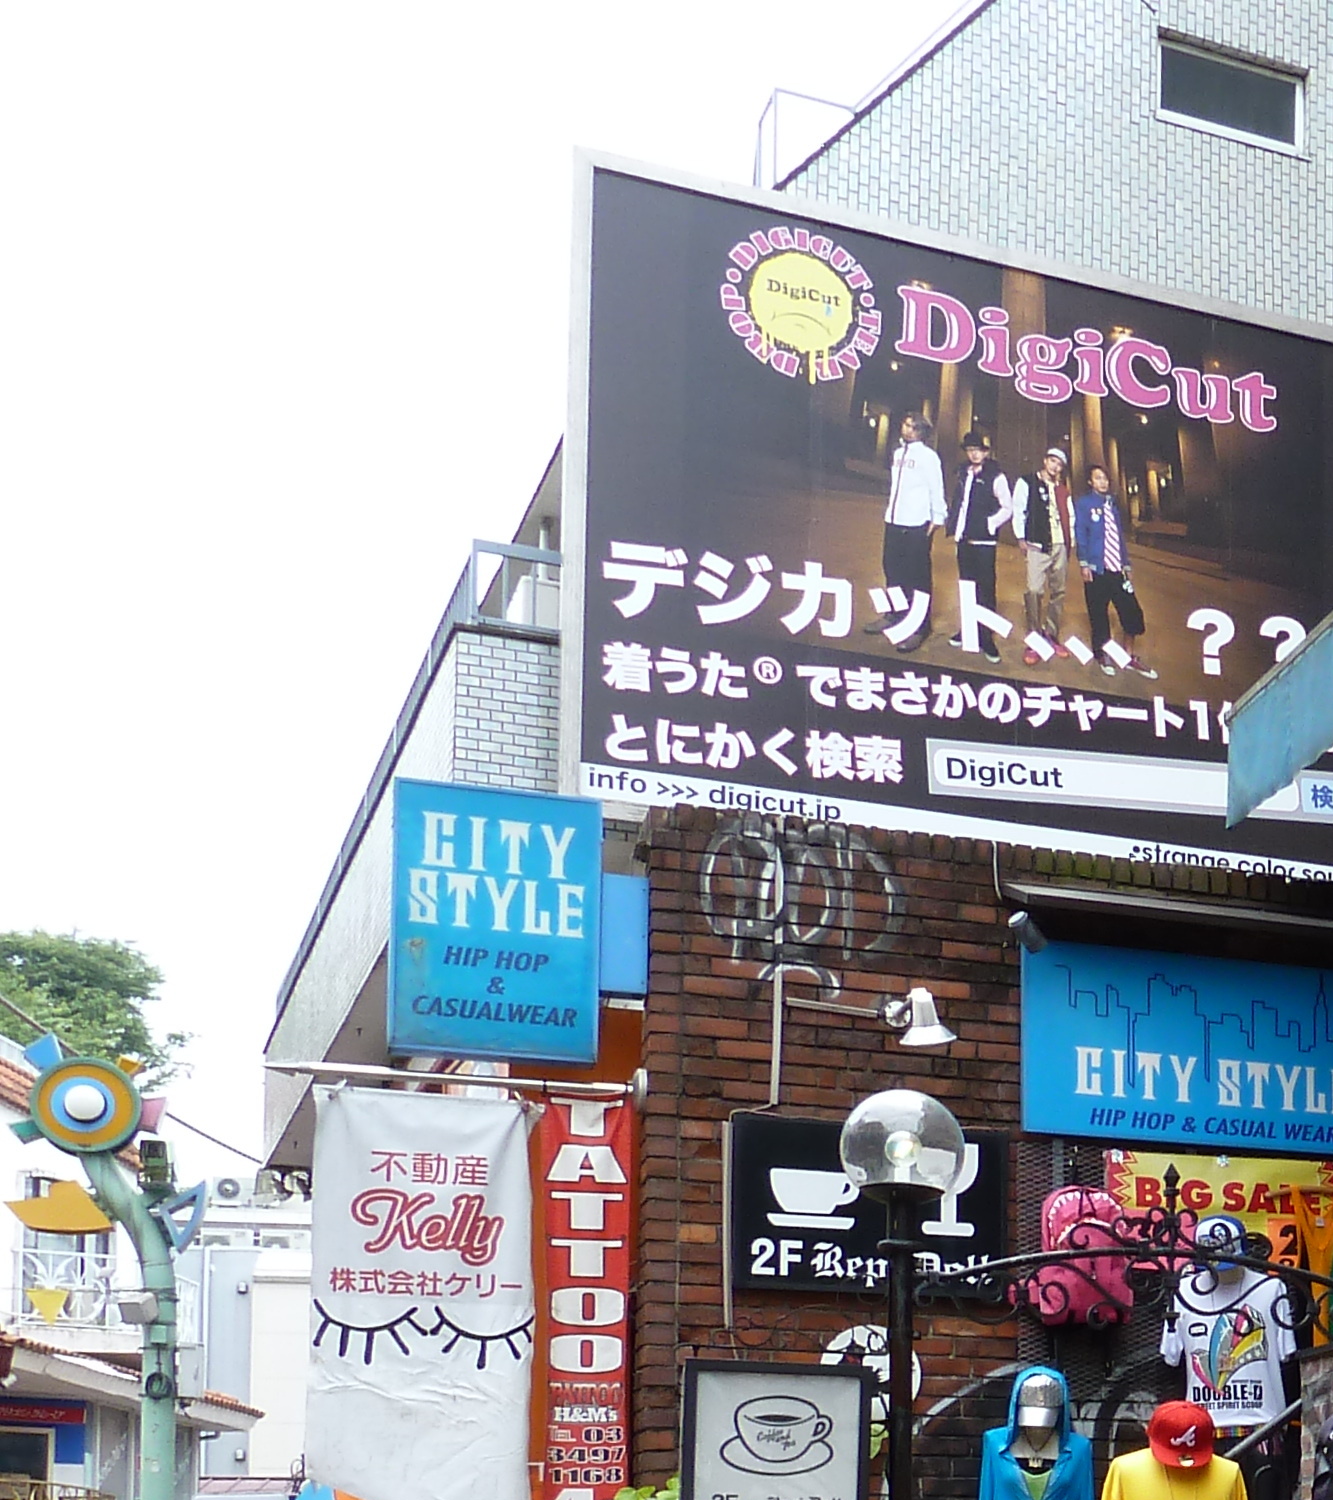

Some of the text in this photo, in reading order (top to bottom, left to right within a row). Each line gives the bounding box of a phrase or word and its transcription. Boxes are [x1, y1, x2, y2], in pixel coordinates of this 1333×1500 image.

[766, 278, 841, 307] DigiCut
[894, 285, 1278, 433] DigiCut
[604, 713, 904, 784] とにかく検索
[946, 756, 1064, 790] DigiCut
[588, 766, 842, 822] info digicut.jp
[421, 810, 577, 880] CITY
[408, 867, 586, 940] STYLE
[443, 945, 550, 974] HIP HOP
[485, 976, 506, 995] &
[411, 995, 578, 1029] CASUALWEAR
[1074, 1045, 1198, 1103] CITY
[1089, 1107, 1127, 1129] HIP
[1131, 1110, 1176, 1132] HOP
[1180, 1114, 1198, 1133] &
[1203, 1116, 1278, 1140] CASUAL
[369, 1149, 489, 1187] 不動産
[350, 1187, 507, 1267] Kelly
[545, 1097, 627, 1374] TATTOO
[750, 1237, 804, 1276] 2F
[810, 1241, 890, 1289] Rep
[328, 1266, 524, 1299] 株式会社ケリー
[553, 1404, 618, 1424] H&M's
[582, 1426, 624, 1444] 03
[548, 1446, 627, 1464] 3497
[548, 1467, 625, 1485] 1168
